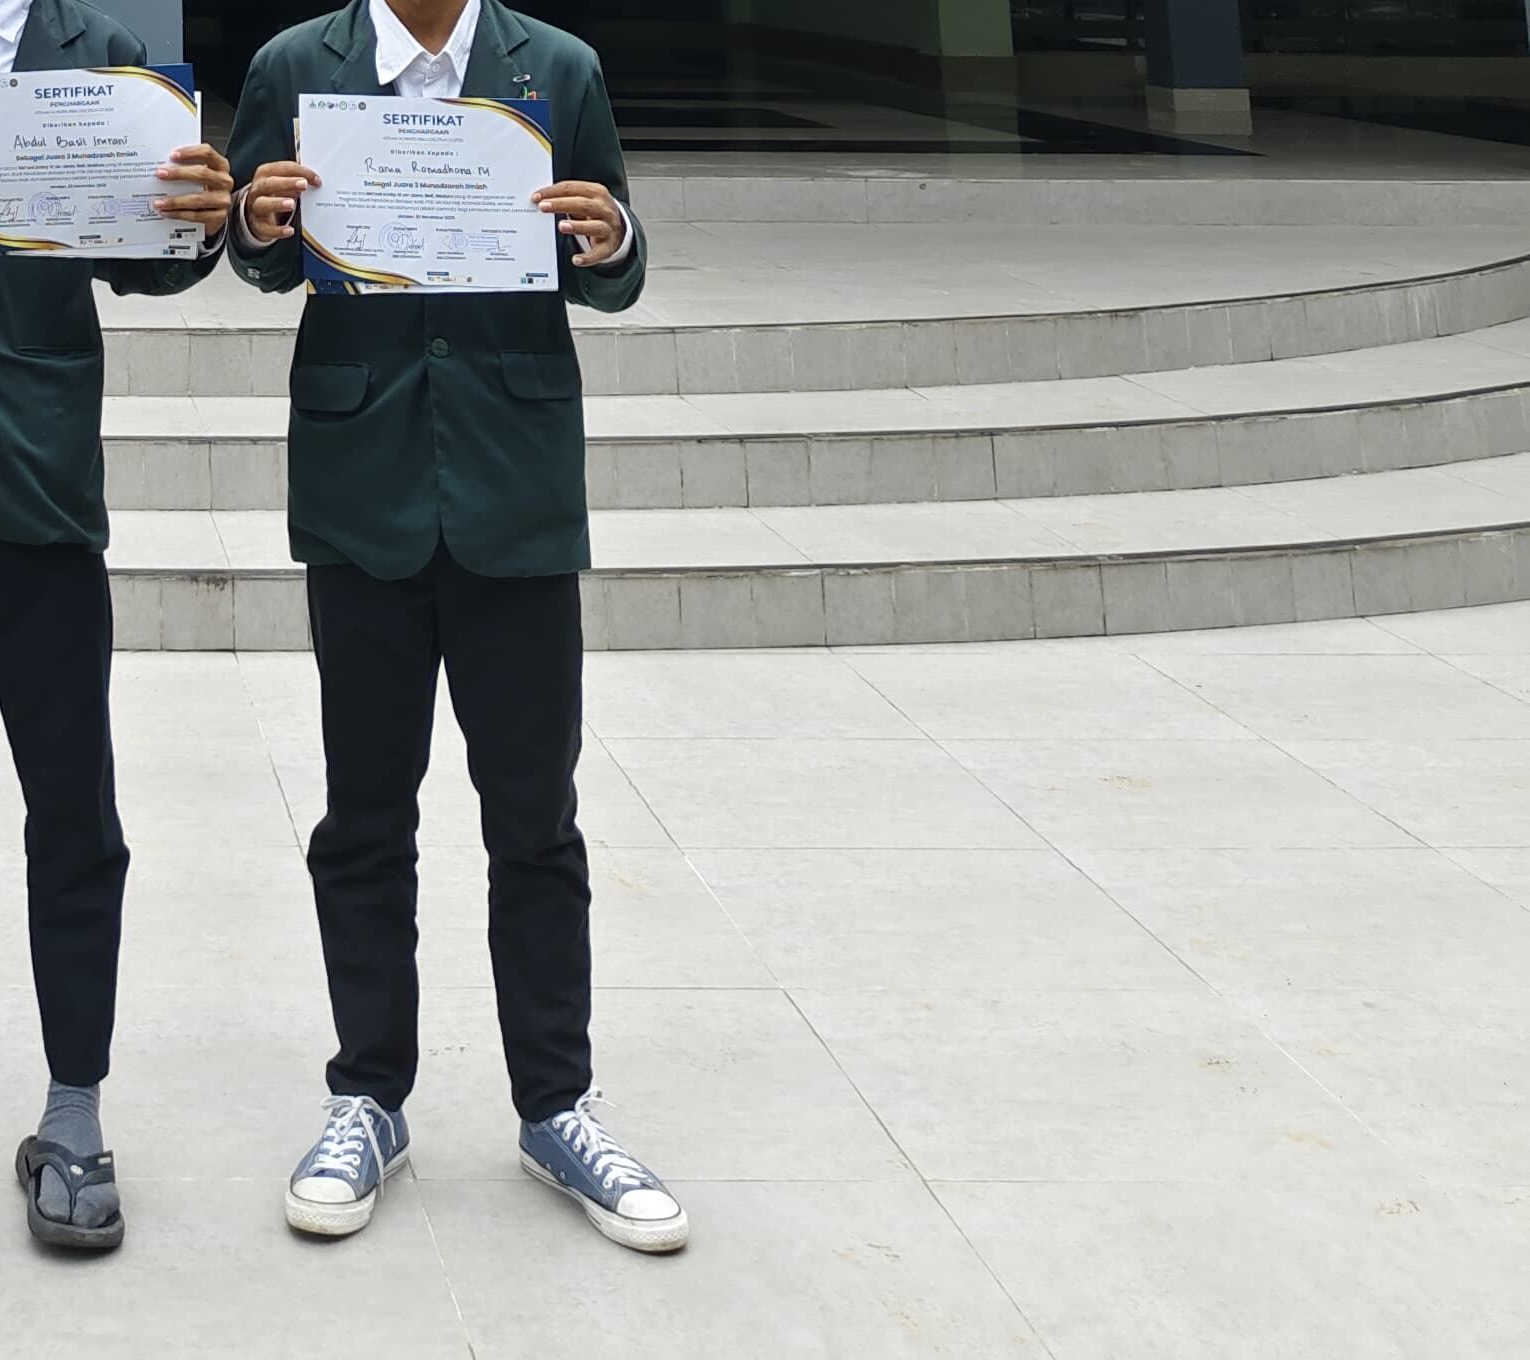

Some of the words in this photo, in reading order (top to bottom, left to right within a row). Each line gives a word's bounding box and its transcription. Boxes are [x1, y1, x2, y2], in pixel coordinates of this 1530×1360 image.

[34, 85, 114, 99] SERTIFIKAT
[382, 113, 465, 127] SERTIFIKAT
[13, 134, 47, 150] Abdul
[56, 136, 87, 149] Basil
[93, 135, 128, 147] Imrani
[364, 157, 402, 174] Rama
